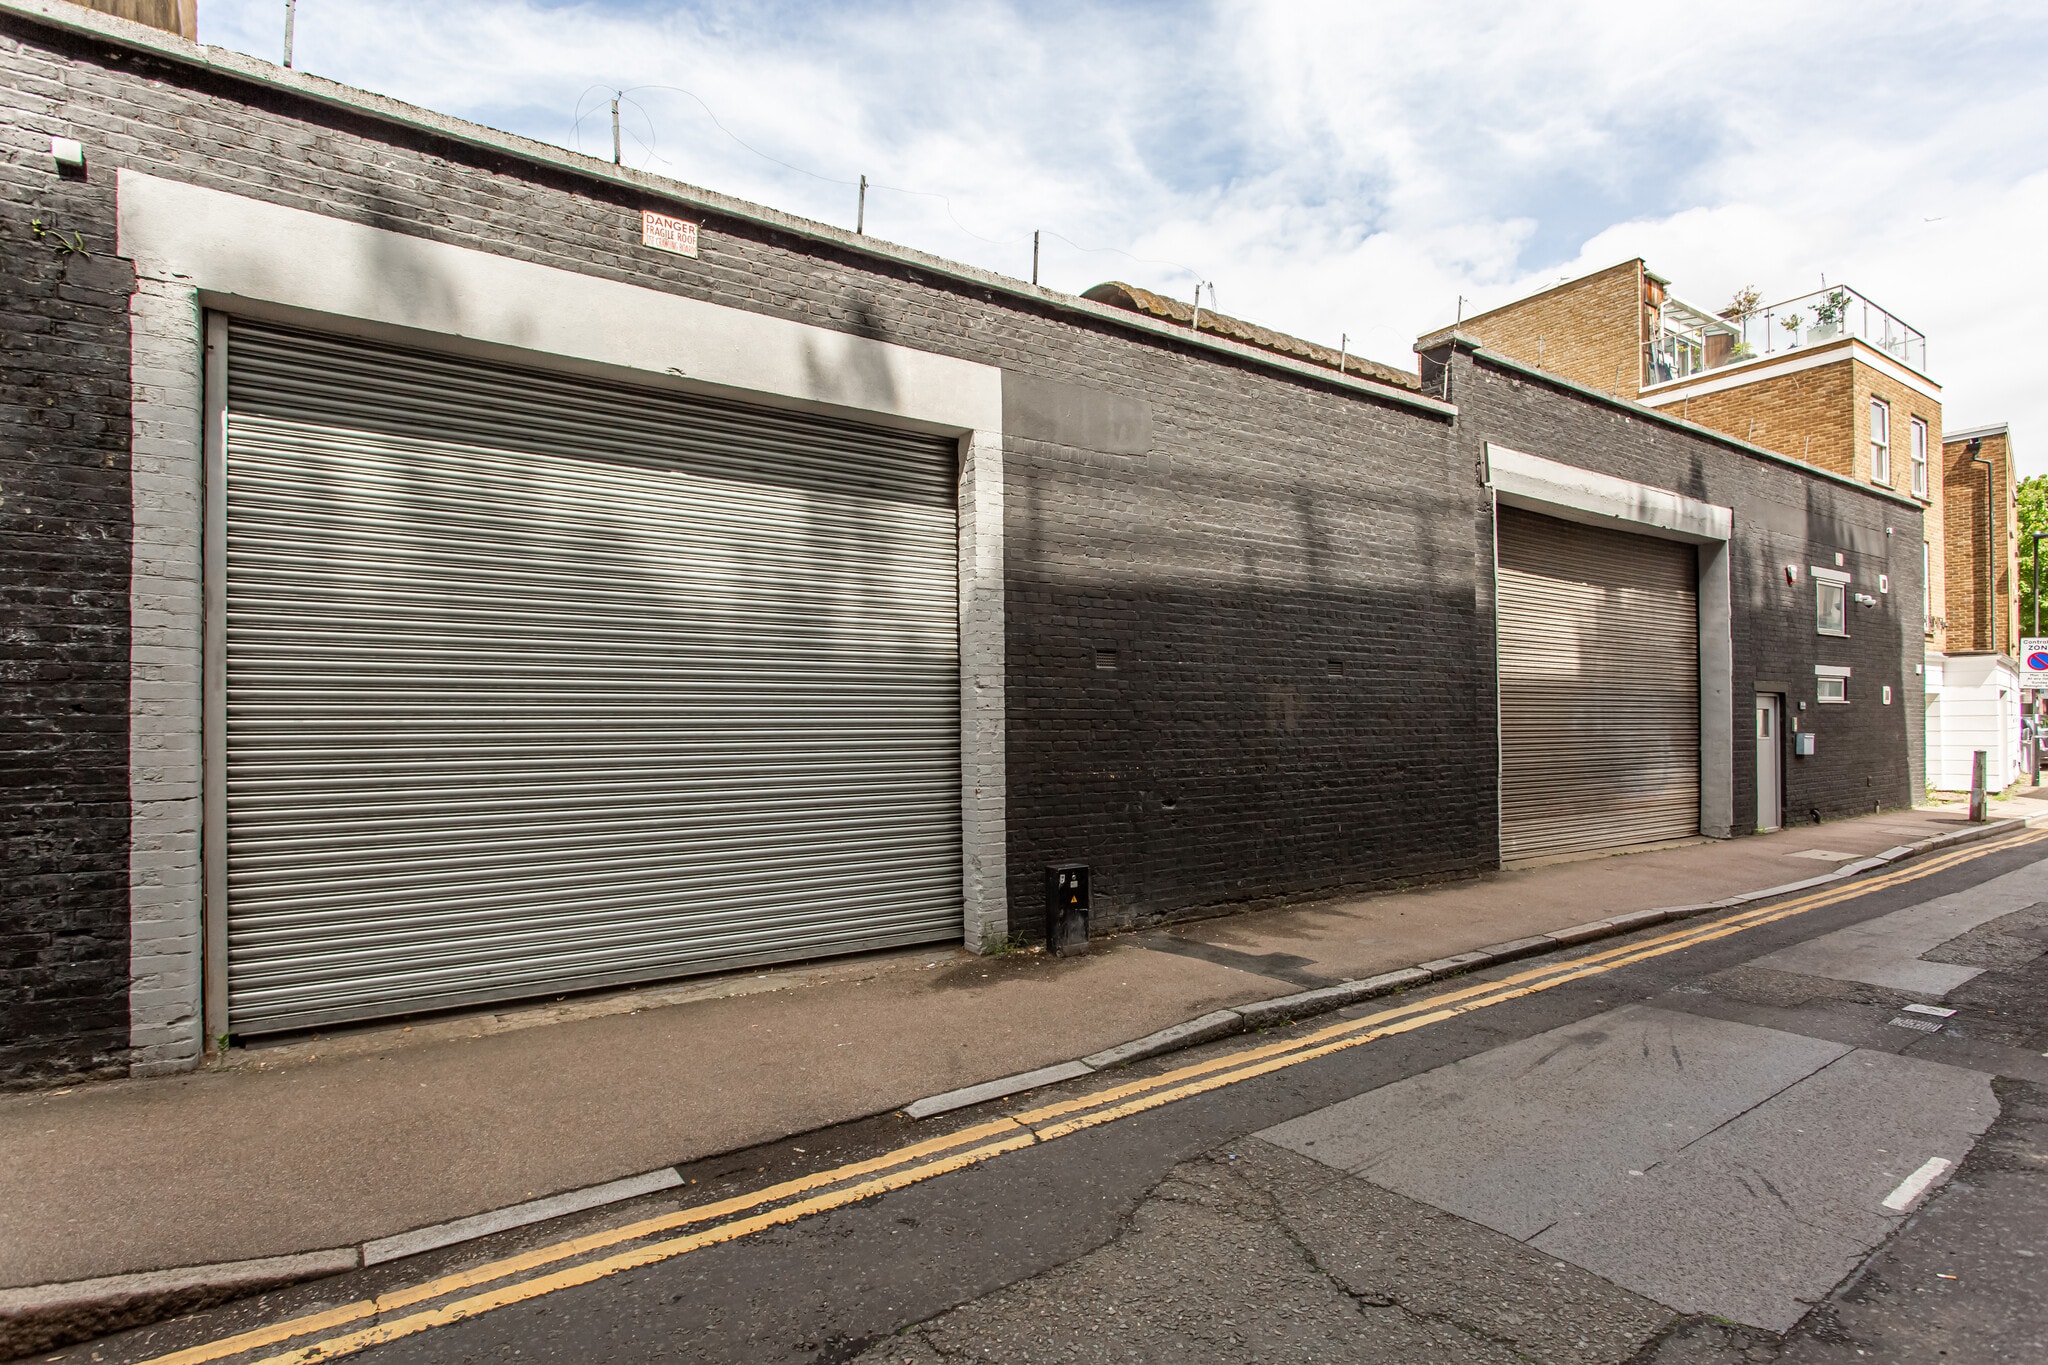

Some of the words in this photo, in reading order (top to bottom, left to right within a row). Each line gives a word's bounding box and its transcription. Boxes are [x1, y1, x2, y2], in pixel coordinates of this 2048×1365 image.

[646, 214, 696, 235] DANGER
[646, 224, 675, 240] FRAGILE
[677, 232, 696, 245] ROOF
